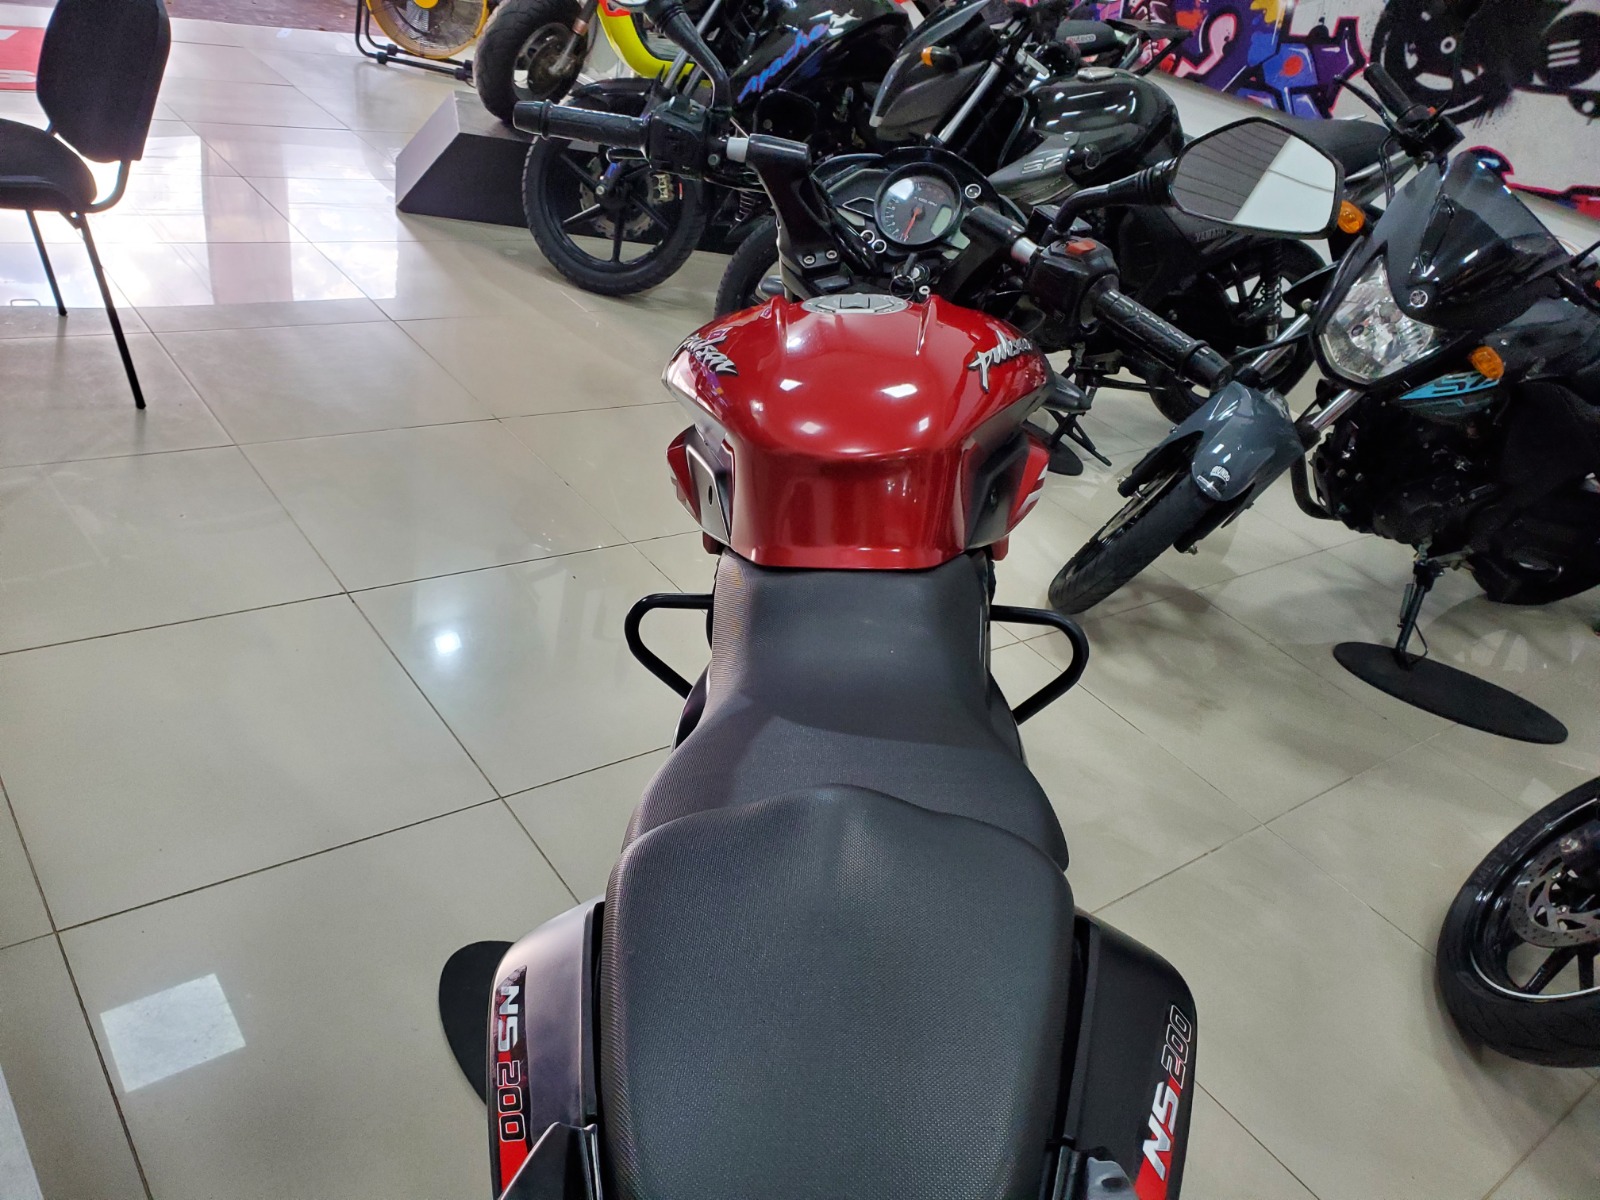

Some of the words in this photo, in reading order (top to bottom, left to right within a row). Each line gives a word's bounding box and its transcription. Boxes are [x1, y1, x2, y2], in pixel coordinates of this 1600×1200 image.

[1195, 227, 1227, 242] YAMAHA
[498, 985, 520, 1052] NS
[1160, 1004, 1193, 1090] 200
[497, 1060, 526, 1142] 200
[1142, 1081, 1179, 1182] NS
